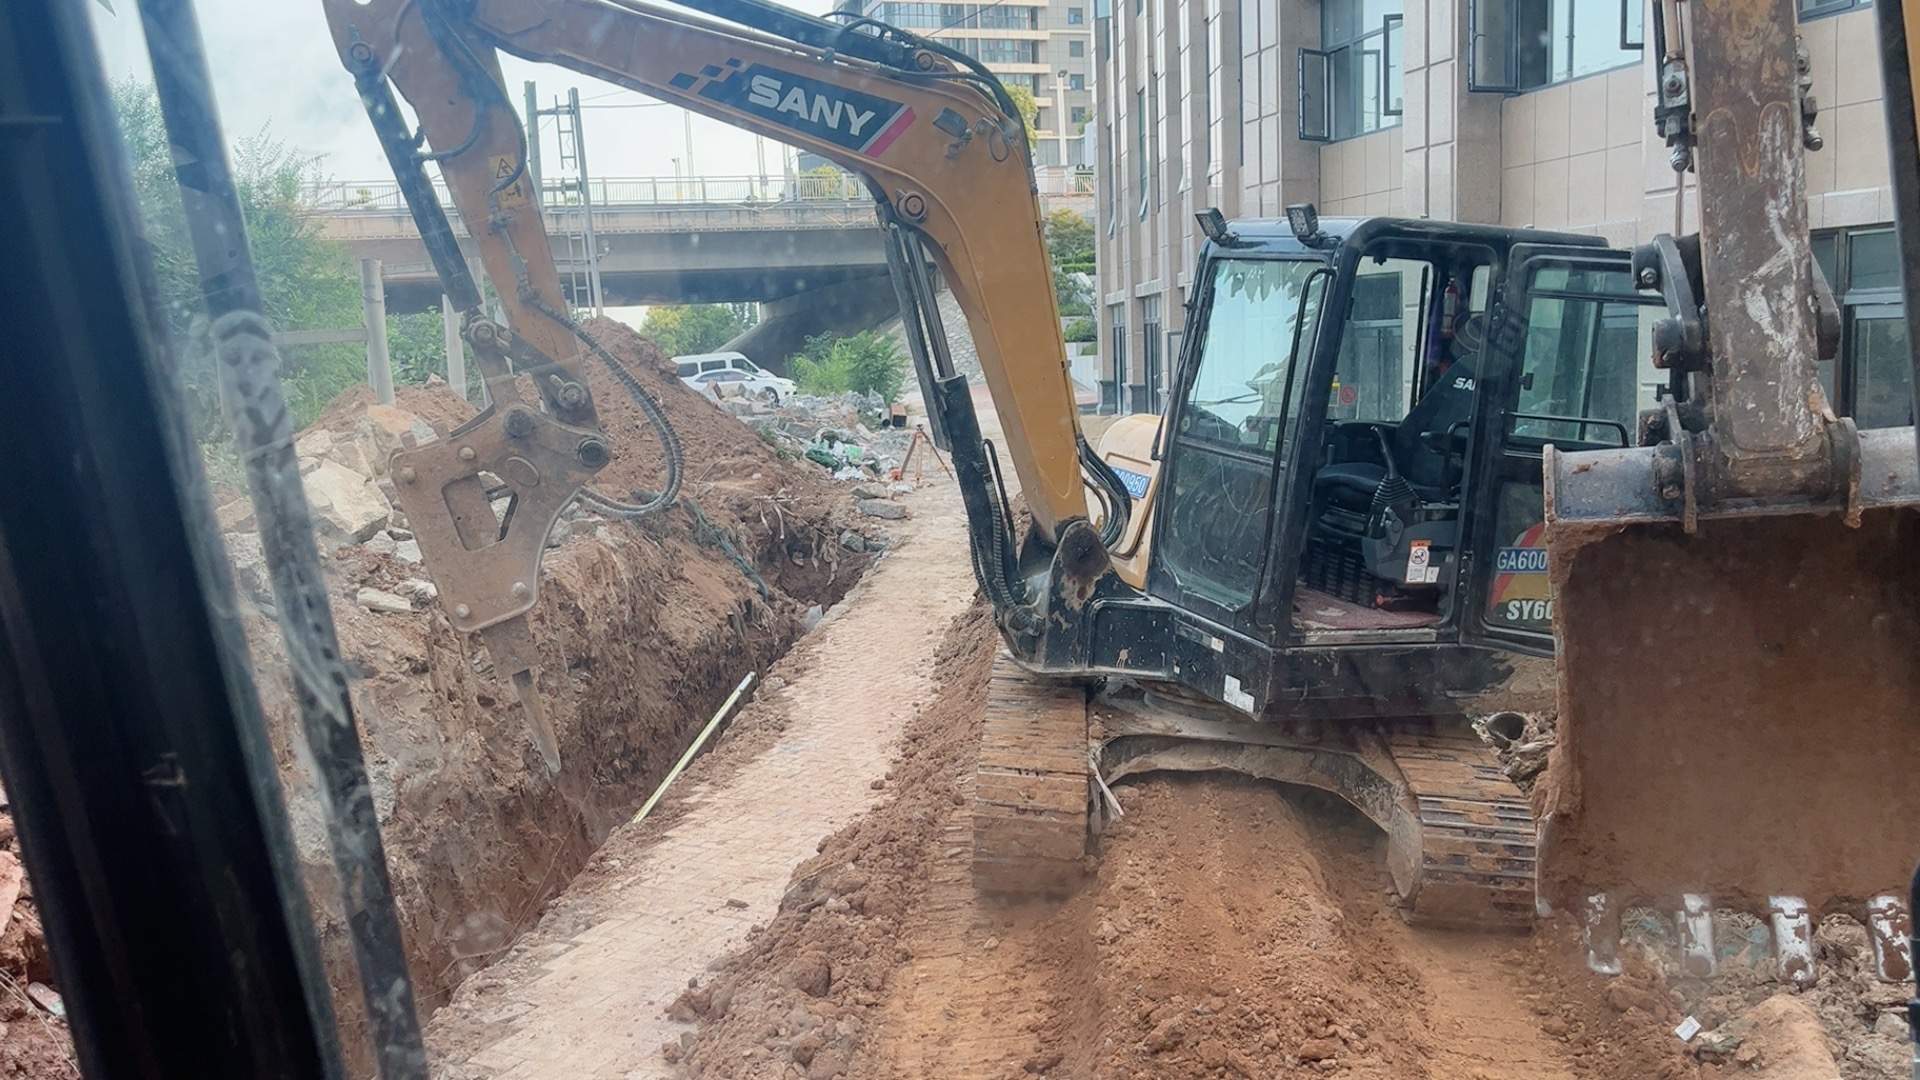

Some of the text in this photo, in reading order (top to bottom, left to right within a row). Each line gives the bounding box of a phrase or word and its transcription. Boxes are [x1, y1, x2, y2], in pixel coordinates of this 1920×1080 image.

[748, 75, 875, 136] SANY
[1453, 377, 1476, 391] SA
[1497, 551, 1548, 569] GA600
